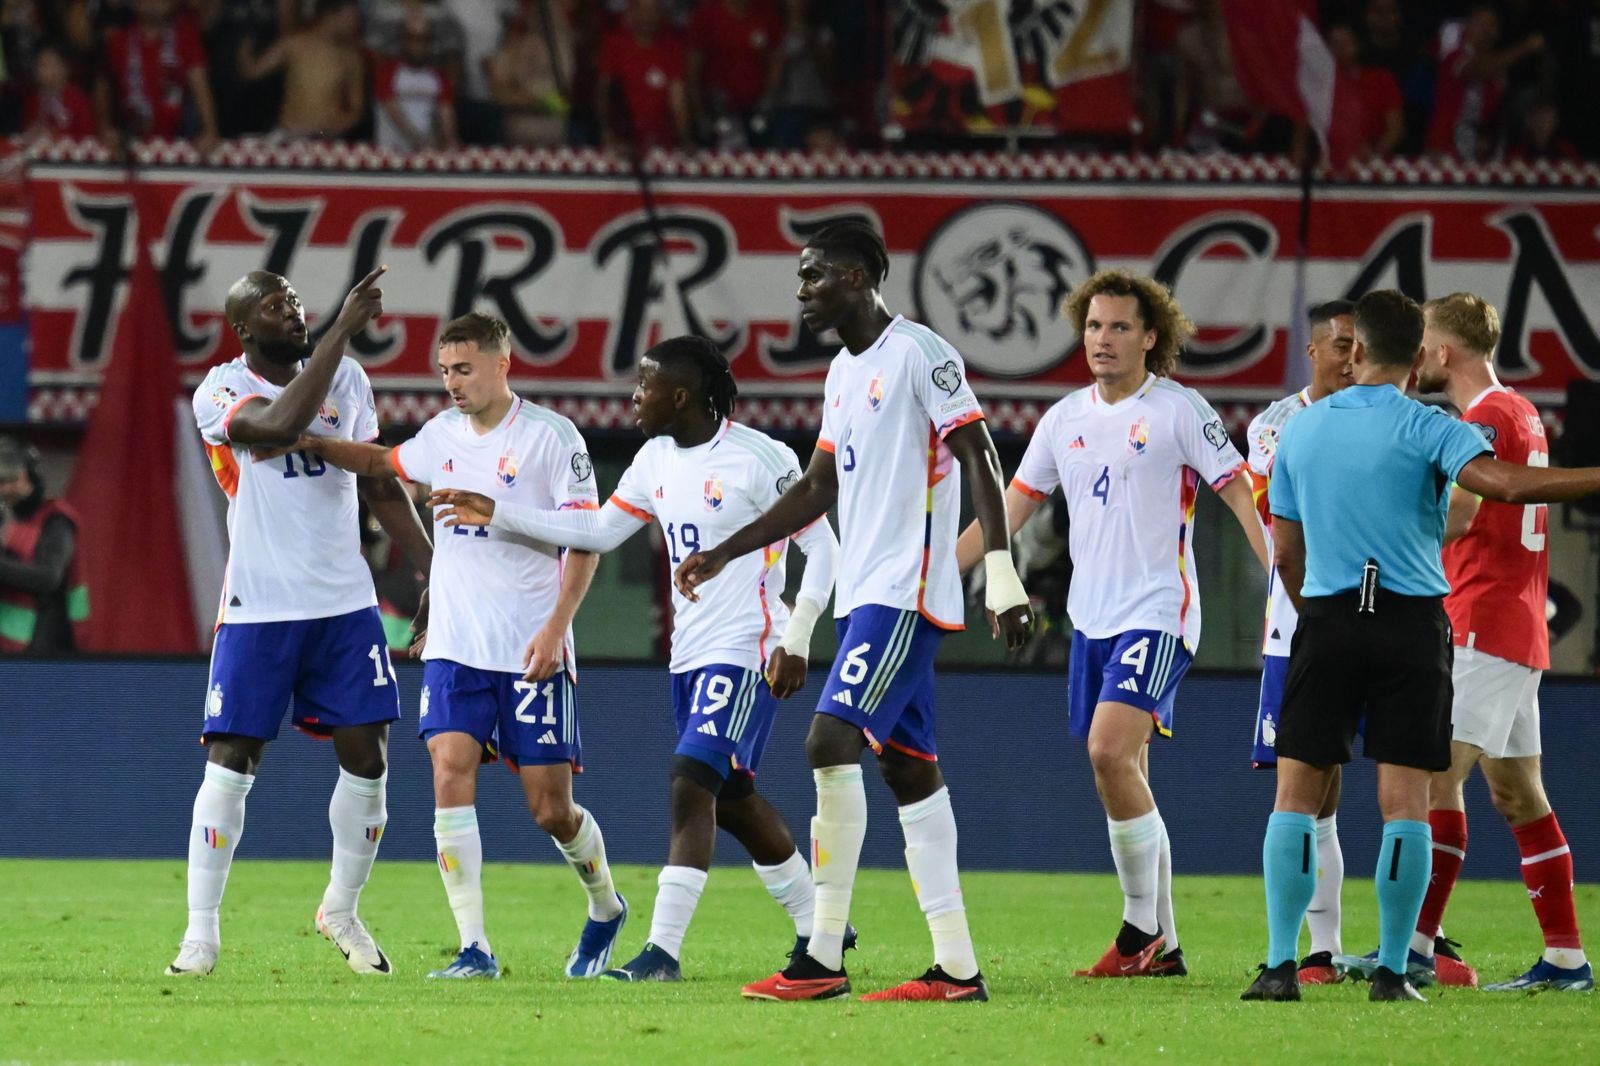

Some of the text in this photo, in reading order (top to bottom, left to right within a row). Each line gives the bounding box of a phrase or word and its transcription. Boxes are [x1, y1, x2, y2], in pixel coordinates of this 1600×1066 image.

[1092, 465, 1110, 506] 4
[667, 522, 701, 563] 19
[368, 643, 397, 687] 1
[840, 641, 871, 685] 6
[1120, 636, 1150, 676] 4
[513, 680, 557, 725] 21
[690, 672, 734, 715] 19
